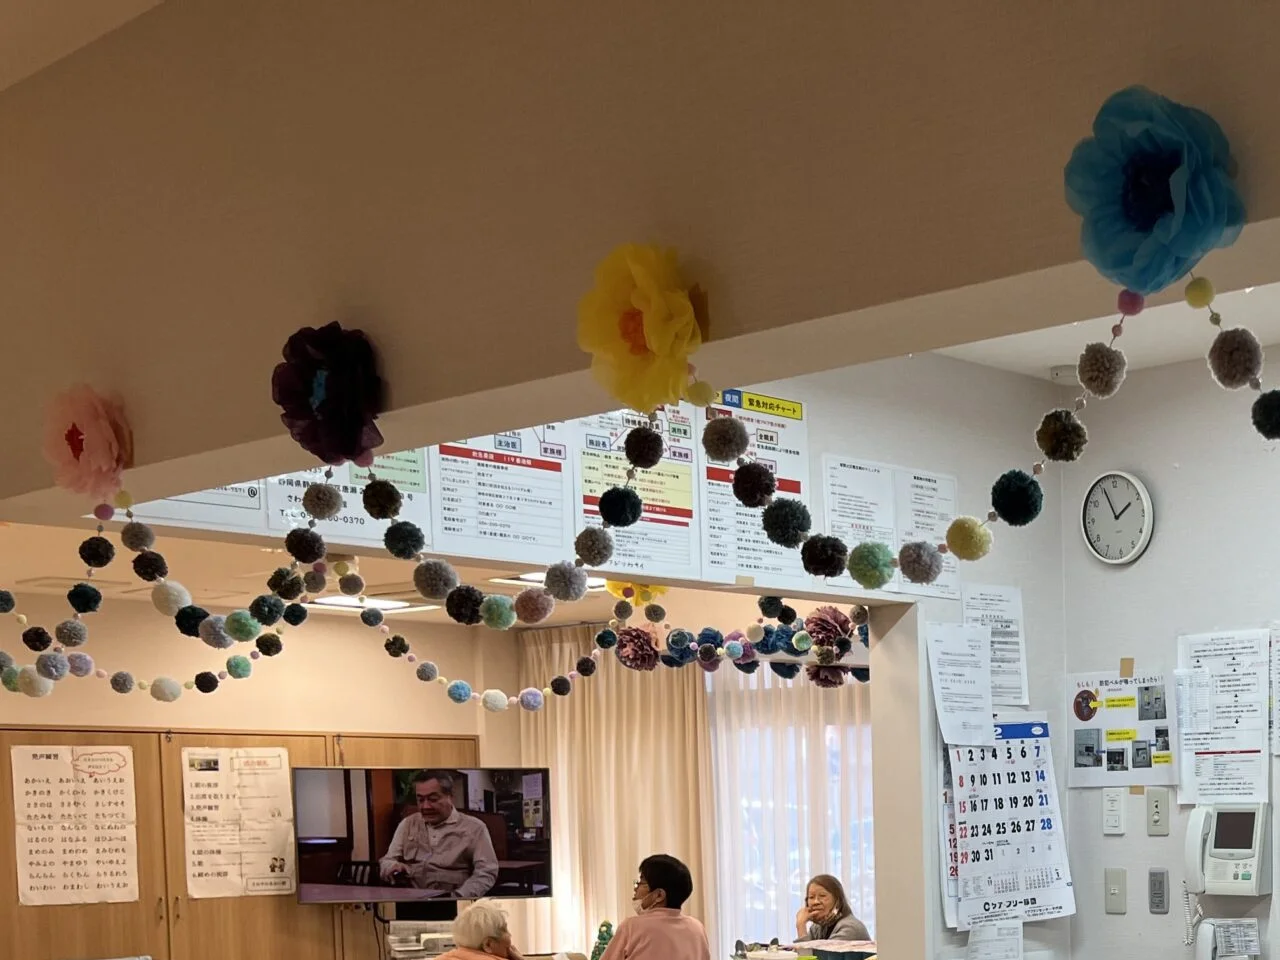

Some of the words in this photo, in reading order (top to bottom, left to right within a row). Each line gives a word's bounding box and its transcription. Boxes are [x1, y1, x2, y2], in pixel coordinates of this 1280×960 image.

[725, 394, 740, 404] 夜間
[748, 398, 797, 415] 緊急対応チャート
[1112, 480, 1118, 488] 12
[956, 750, 960, 762] 1
[968, 750, 974, 760] 2
[980, 749, 985, 760] 3
[992, 748, 998, 760] 4
[1006, 747, 1012, 759] 5
[1020, 746, 1026, 758] 6
[1035, 746, 1040, 757] 7
[959, 776, 964, 788] 8
[970, 774, 975, 786] 9
[980, 774, 987, 786] 10
[992, 773, 1000, 784] 11
[1007, 772, 1016, 784] 12
[1021, 771, 1030, 782] 13
[1036, 770, 1046, 782] 14
[959, 801, 966, 813] 15
[970, 800, 977, 812] 16
[981, 799, 988, 811] 17
[994, 798, 1004, 810] 18
[1009, 796, 1018, 808] 19
[1023, 796, 1034, 807] 20
[1038, 794, 1048, 806] 21
[960, 826, 968, 838] 22
[970, 825, 978, 838] 23
[982, 824, 992, 836] 24
[996, 822, 1006, 834] 25
[1010, 821, 1022, 833] 26
[1026, 820, 1035, 832] 27
[1040, 818, 1052, 830] 28
[960, 852, 968, 864] 29
[972, 850, 980, 862] 30
[984, 849, 994, 860] 31
